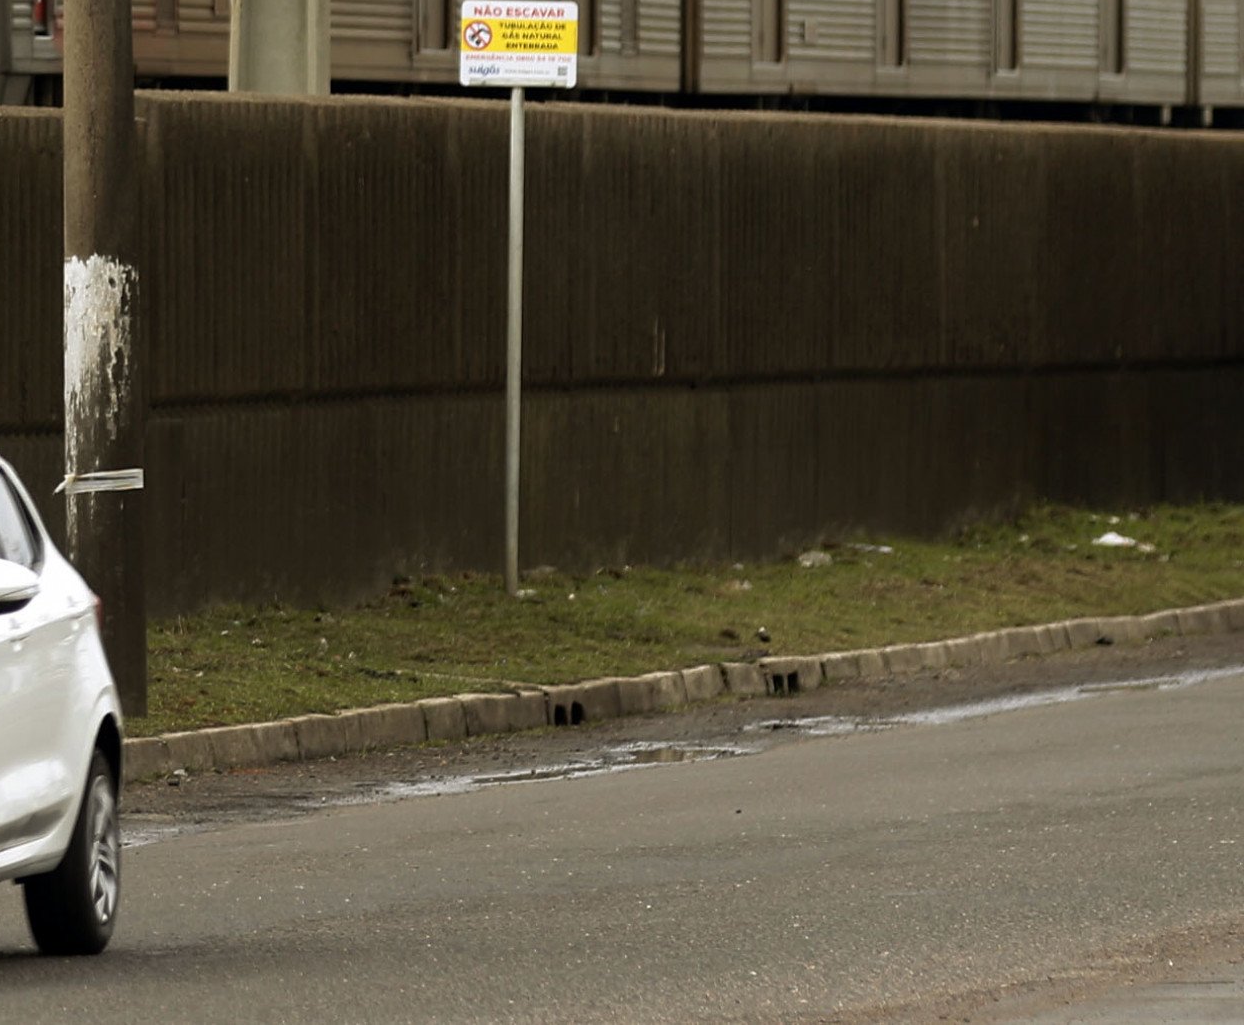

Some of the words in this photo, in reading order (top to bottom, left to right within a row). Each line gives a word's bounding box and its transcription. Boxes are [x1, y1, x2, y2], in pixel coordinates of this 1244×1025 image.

[474, 5, 503, 17] NÃO
[506, 7, 566, 18] ESCAVAR
[500, 22, 553, 32] TUBULAÇÃO
[506, 43, 559, 51] ENTERRADA
